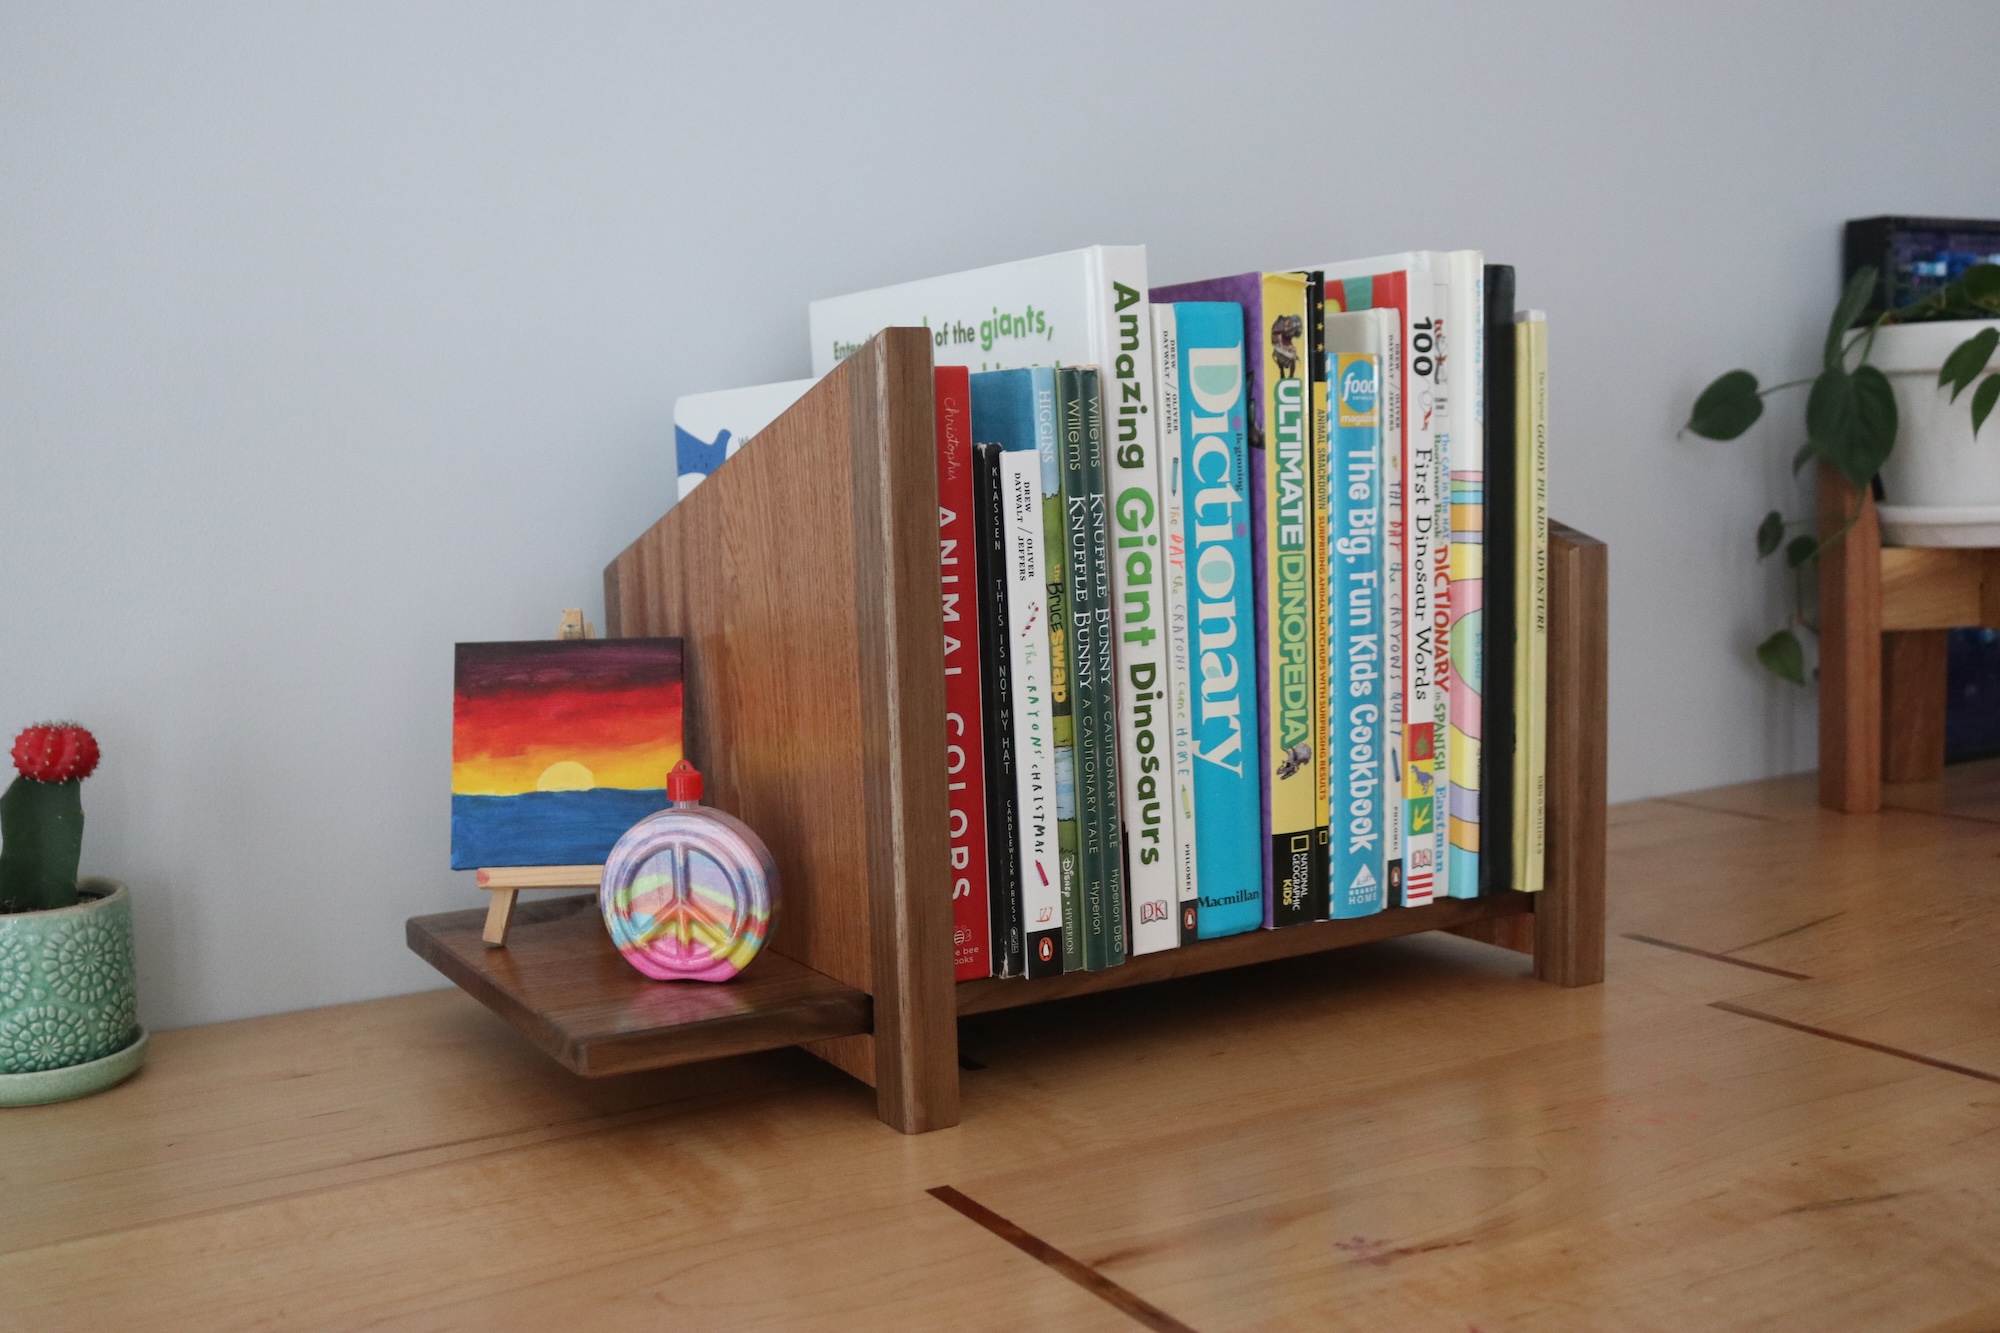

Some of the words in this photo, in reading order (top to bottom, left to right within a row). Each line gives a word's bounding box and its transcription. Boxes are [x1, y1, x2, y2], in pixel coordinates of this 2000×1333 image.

[935, 321, 949, 347] of
[953, 320, 975, 344] the
[980, 305, 1054, 351] giants,
[1413, 317, 1433, 376] 100
[1113, 280, 1148, 469] Amazing
[1343, 372, 1379, 402] food
[1038, 390, 1054, 464] HIGGINS
[1067, 398, 1082, 471] Willems
[1088, 396, 1101, 468] Willems
[1316, 408, 1326, 445] ANIMAL
[1442, 433, 1450, 454] The
[1536, 423, 1546, 473] GOODY
[1234, 432, 1245, 491] Beginning
[1276, 378, 1305, 547] ULTIMATE
[1317, 447, 1327, 510] SMACKDOWN
[1348, 446, 1377, 500] The
[1414, 449, 1433, 506] First
[1442, 457, 1450, 478] CAT
[991, 466, 1001, 550] KLASSEN
[1014, 472, 1024, 523] DAYWALT
[1023, 481, 1032, 513] DREW
[1170, 505, 1181, 526] The
[1442, 495, 1450, 514] the
[1537, 479, 1546, 504] PIE
[1068, 495, 1088, 602] KNUFFLE
[1089, 492, 1108, 598] KNUFFLE
[1317, 515, 1327, 574] SURPRISING
[1337, 507, 1377, 563] Big,
[1442, 518, 1450, 540] HAT
[1537, 505, 1546, 544] KIDS'
[1017, 535, 1026, 582] JEFFERS
[1026, 538, 1035, 578] OLIVER
[1115, 486, 1158, 647] Giant
[1169, 533, 1185, 570] DAY
[1188, 339, 1243, 779] Dictionary
[1414, 516, 1433, 621] Dinosaur
[995, 579, 1005, 627] THIS
[1171, 575, 1184, 594] the
[1318, 576, 1327, 614] ANIMAL
[1349, 570, 1377, 627] Fun
[1536, 546, 1546, 634] ADVENTURE
[1172, 604, 1186, 671] CRAYONS
[1318, 616, 1328, 670] MATCHUPS
[1434, 545, 1451, 693] DICTIONARY
[999, 634, 1006, 658] IS
[1024, 643, 1037, 666] The
[1074, 611, 1092, 690] BUNNY
[1095, 607, 1112, 686] BUNNY
[1281, 555, 1308, 745] DINOPEDIA
[1349, 634, 1379, 697] Kids
[1414, 626, 1433, 700] Words
[999, 665, 1007, 702] NOT
[1082, 698, 1092, 710] A
[1103, 694, 1112, 704] A
[1318, 671, 1328, 700] WITH
[1000, 709, 1009, 731] MY
[1318, 701, 1328, 758] SURPRISING
[1434, 702, 1446, 771] SPANISH
[1002, 738, 1011, 775] HAT
[1082, 715, 1097, 814] CAUTIONARY
[1103, 710, 1117, 808] CAUTIONARY
[1129, 661, 1164, 866] Dinosaurs
[1319, 759, 1328, 801] RESULTS
[1348, 703, 1379, 854] Cookbook
[1006, 800, 1015, 876] CANDLEWICK
[1087, 821, 1099, 855] TALE
[1108, 814, 1118, 850] TALE
[1435, 785, 1447, 873] Eastman
[1291, 853, 1301, 912] GEOGRAPHIC
[1299, 852, 1309, 898] NATIONAL
[1413, 849, 1432, 868] DK
[1090, 880, 1103, 936] Hyperion
[1110, 868, 1121, 923] Hyperion
[1142, 901, 1167, 921] DK
[1197, 888, 1260, 909] Macmillan
[1283, 878, 1293, 906] KIDS
[1349, 892, 1377, 905] HOME
[963, 946, 979, 955] bee
[1064, 907, 1074, 955] HYPERION
[1113, 924, 1123, 953] DBG
[954, 956, 974, 966] ooks
